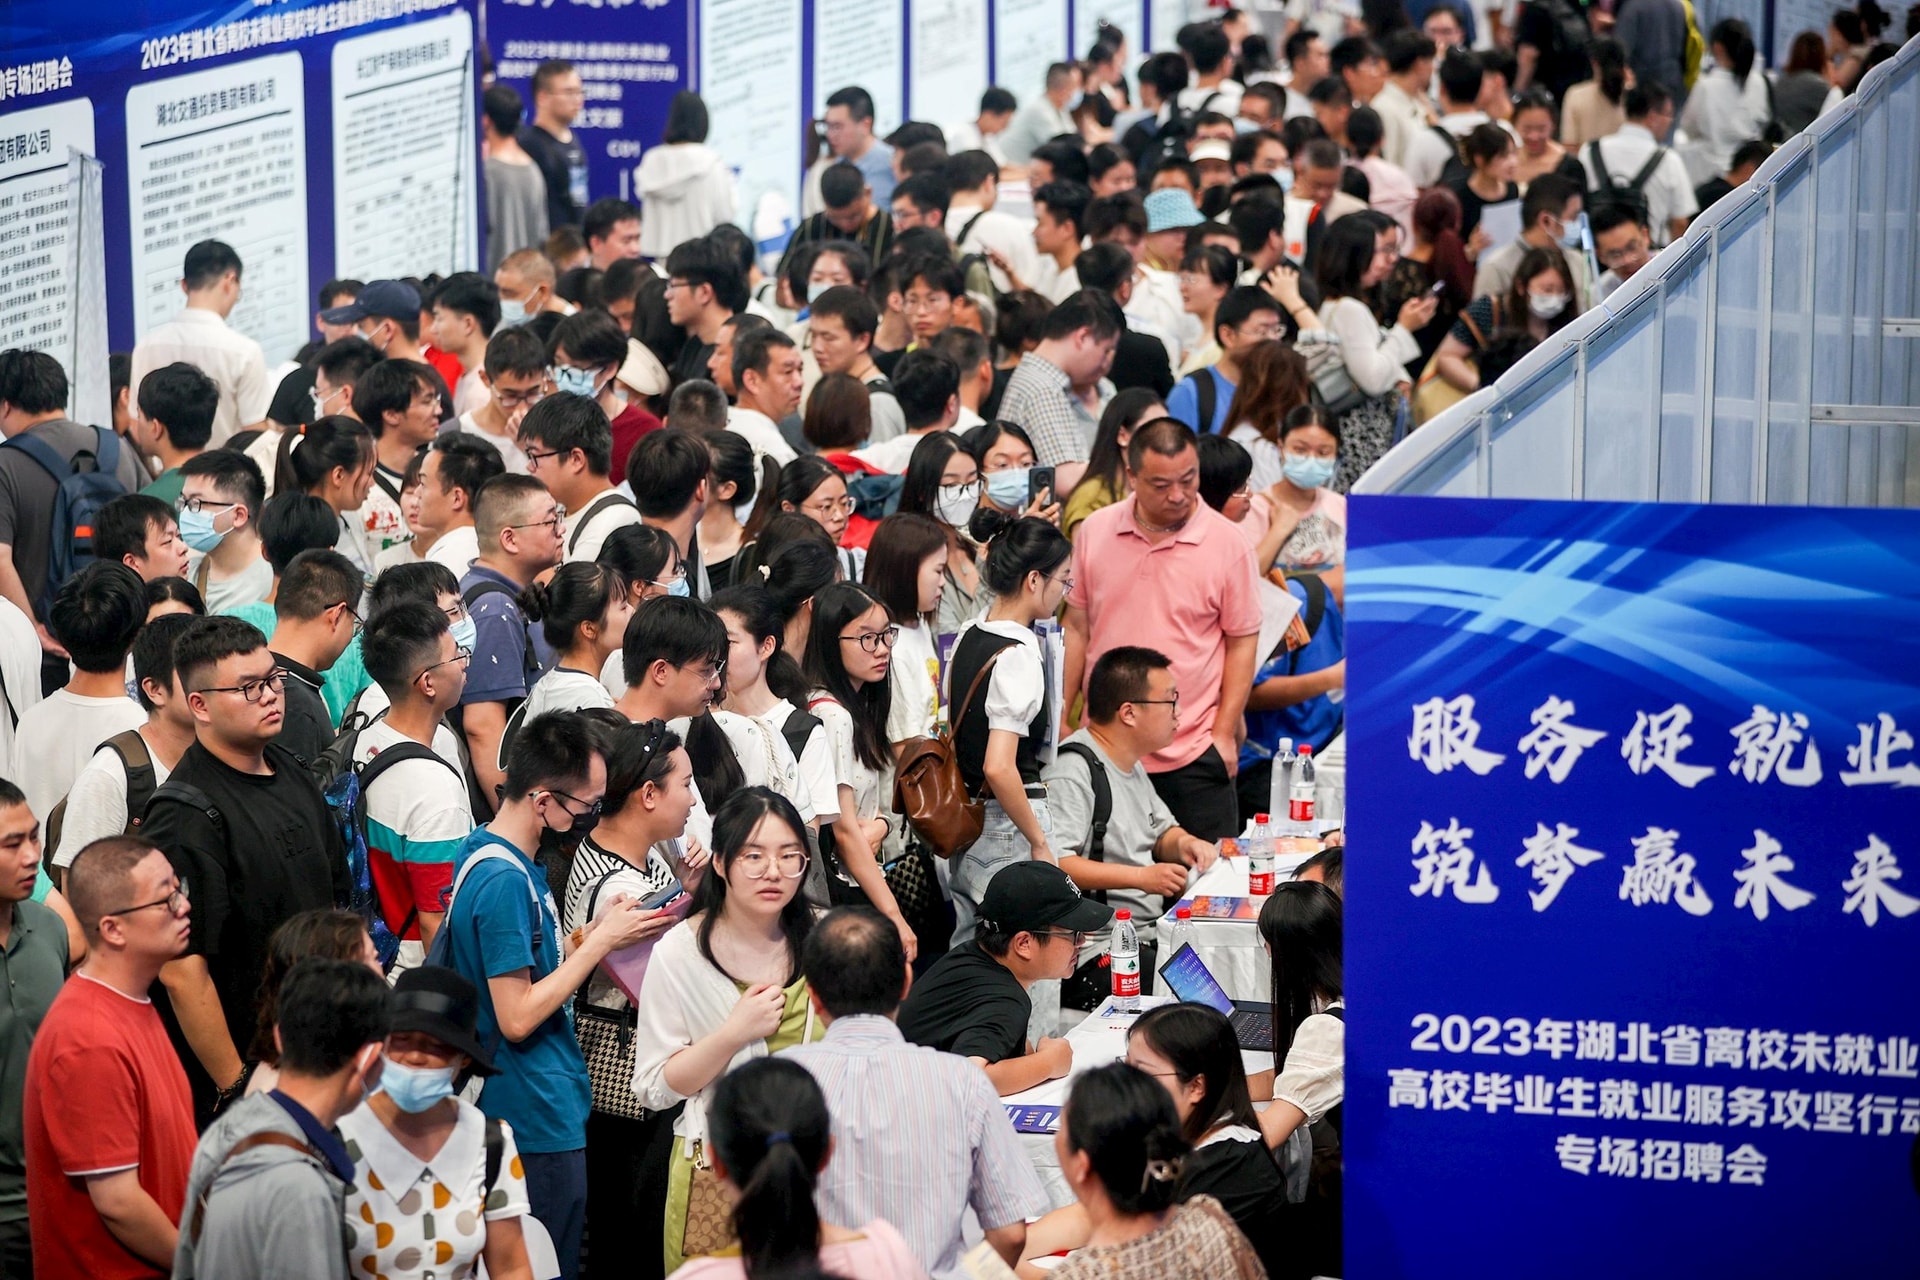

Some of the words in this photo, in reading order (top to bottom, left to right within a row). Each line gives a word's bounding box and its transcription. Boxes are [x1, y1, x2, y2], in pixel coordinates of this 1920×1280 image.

[1408, 694, 1920, 788] 服务促就业
[1410, 817, 1920, 927] 筑梦赢未来
[1410, 1013, 1918, 1077] 2023年湖北省离校未就业
[1554, 1133, 1767, 1185] 专场招聘会
